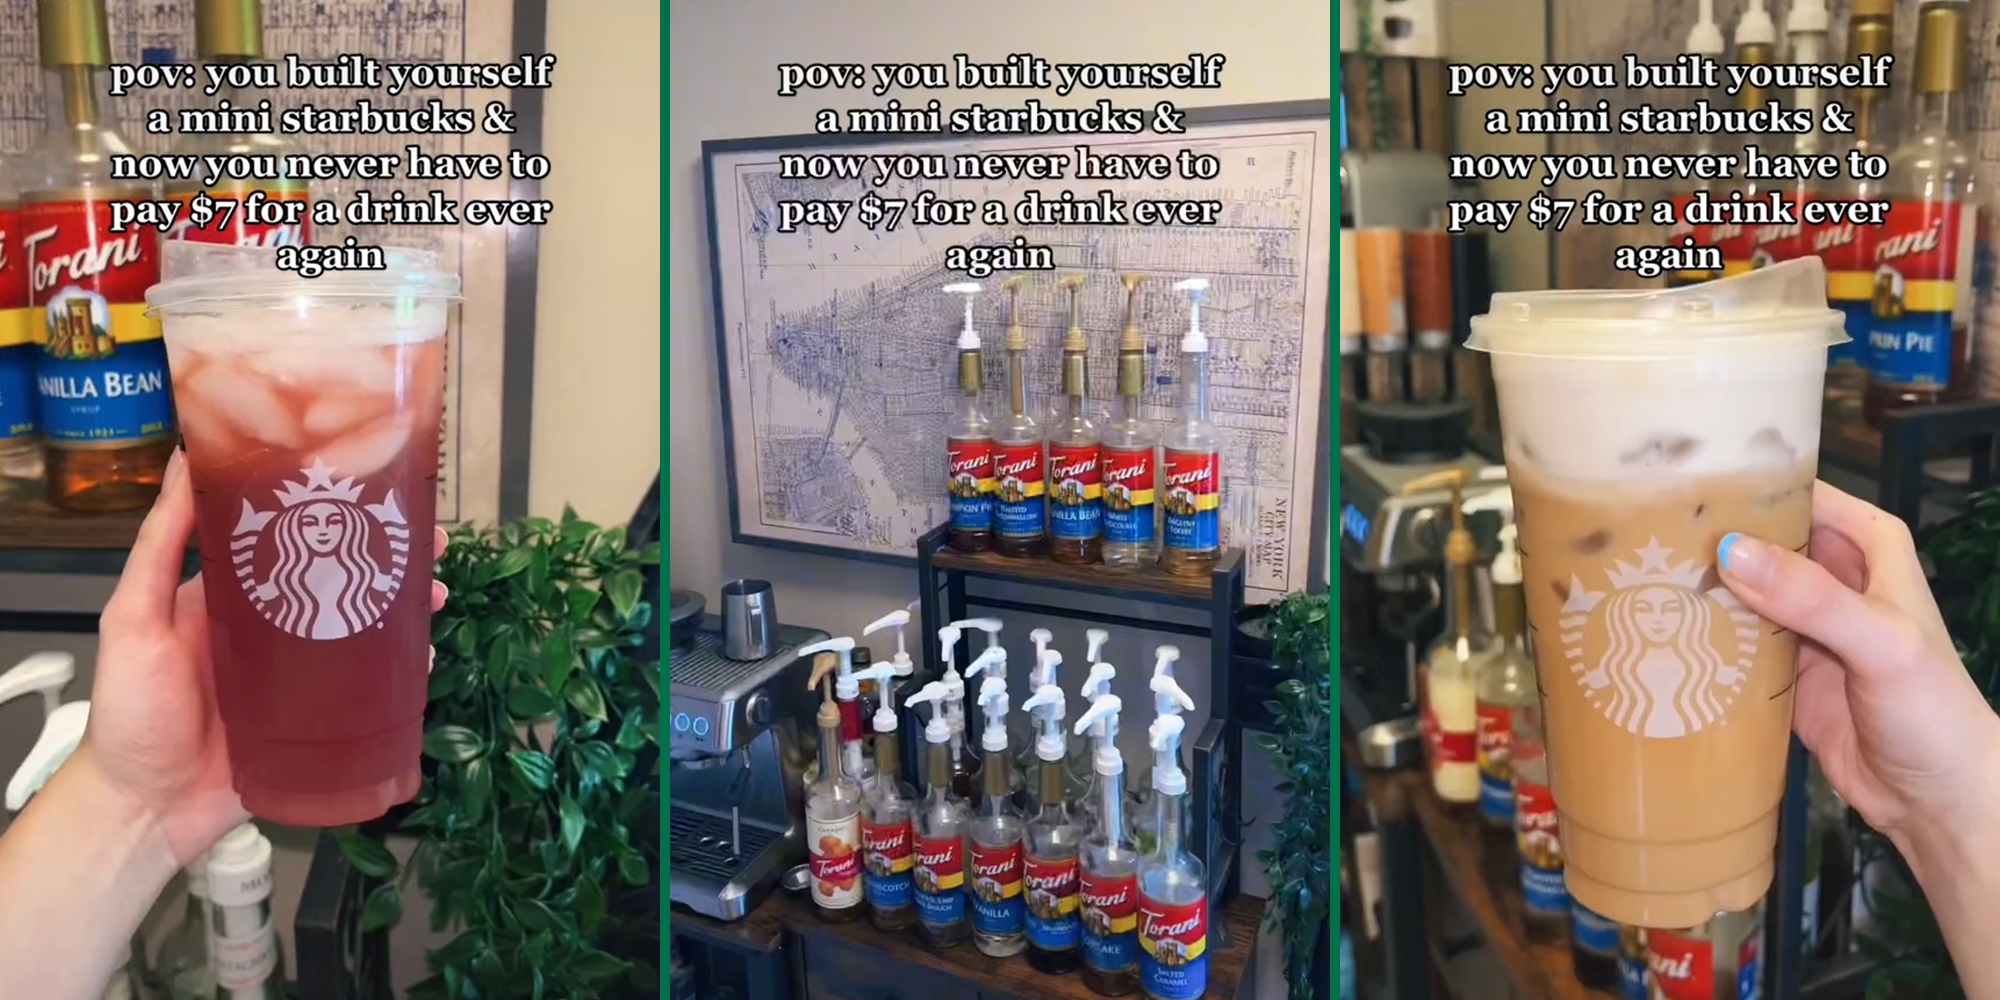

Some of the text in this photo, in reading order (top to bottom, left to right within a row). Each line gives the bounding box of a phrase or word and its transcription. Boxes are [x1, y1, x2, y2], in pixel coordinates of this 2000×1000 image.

[23, 224, 142, 294] Torani
[1905, 331, 1935, 352] PIE
[104, 370, 162, 397] BEAN
[948, 449, 991, 472] Torani
[993, 452, 1038, 476] Torani
[1050, 453, 1097, 479] Torani
[1102, 459, 1147, 482] Torani
[1163, 462, 1213, 486] Torani
[1262, 511, 1275, 565] CITY MAP
[1272, 497, 1288, 581] NEW YORK
[862, 828, 905, 850] Torani
[816, 854, 855, 878] Torani
[970, 850, 1016, 875] Torani
[1022, 859, 1077, 888] Torani
[1079, 877, 1128, 906] Torani
[974, 901, 1010, 918] VANILLA
[1140, 907, 1201, 937] Torani
[1153, 974, 1189, 986] CARAMEL
[1157, 966, 1186, 979] SALTED
